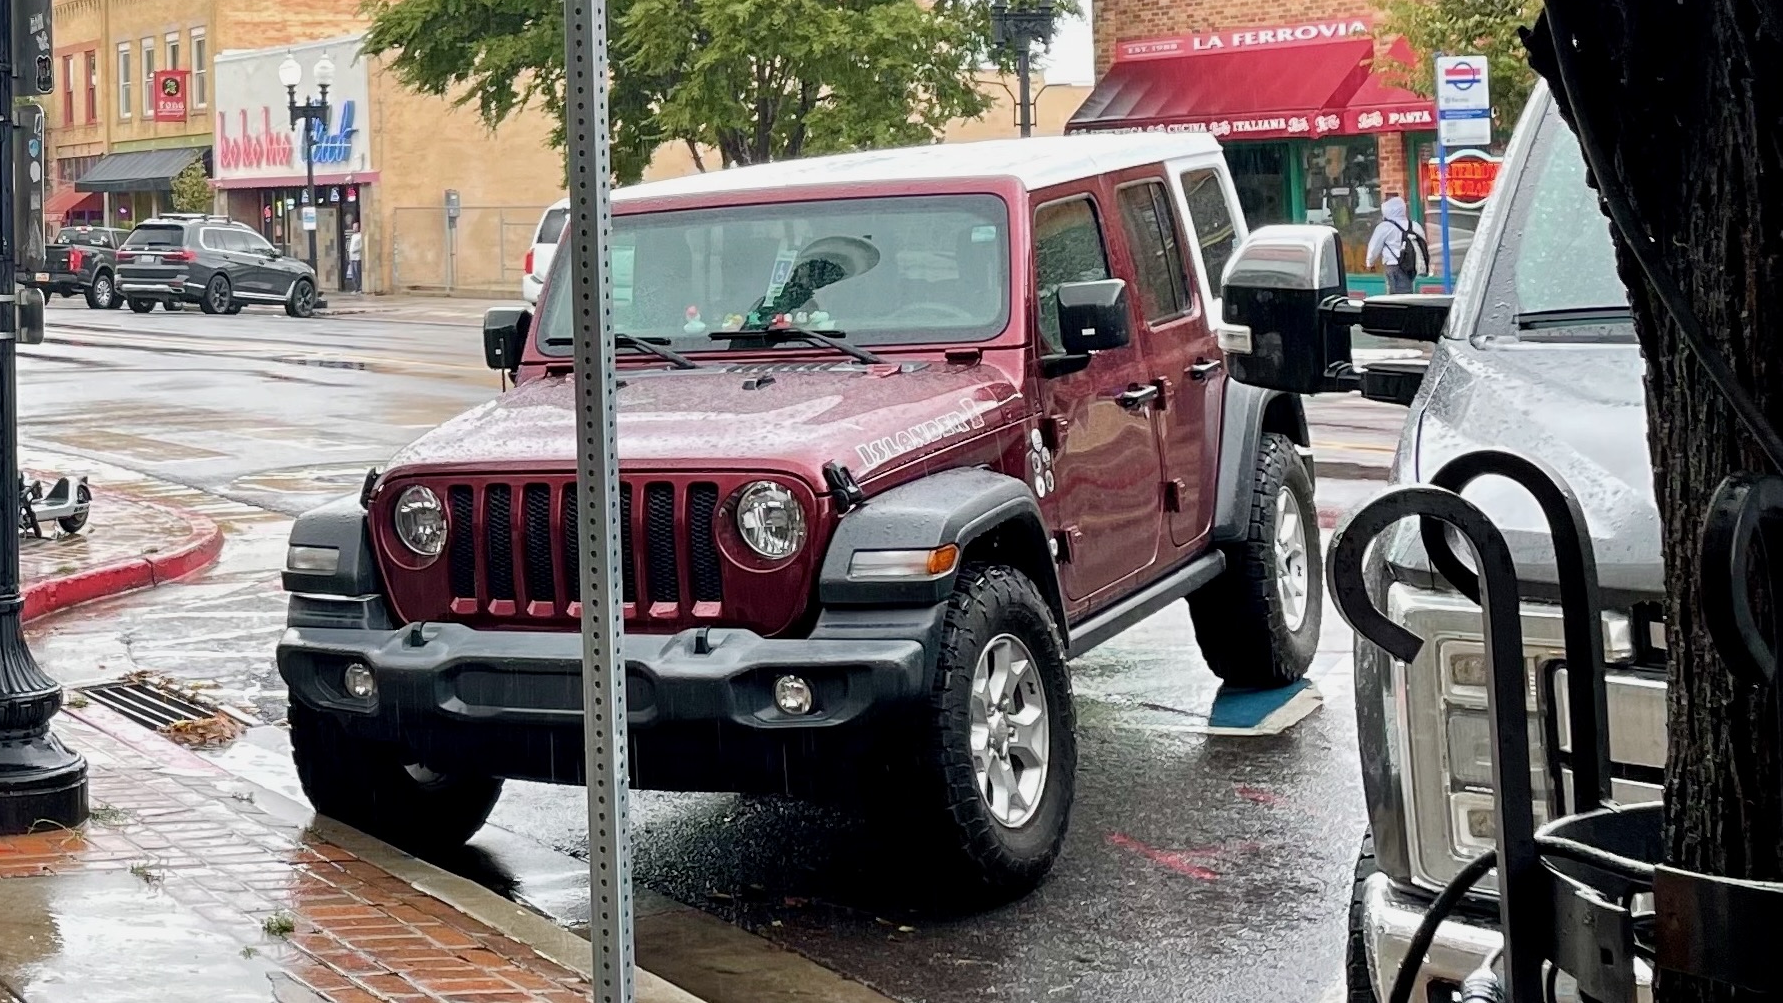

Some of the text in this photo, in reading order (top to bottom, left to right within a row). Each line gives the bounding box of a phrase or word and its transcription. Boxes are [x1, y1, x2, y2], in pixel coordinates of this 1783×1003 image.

[1193, 20, 1368, 51] LA FERROVIA
[1232, 117, 1287, 133] ITALIANA
[1388, 110, 1432, 126] PASTA
[855, 409, 970, 468] ISLANDER
